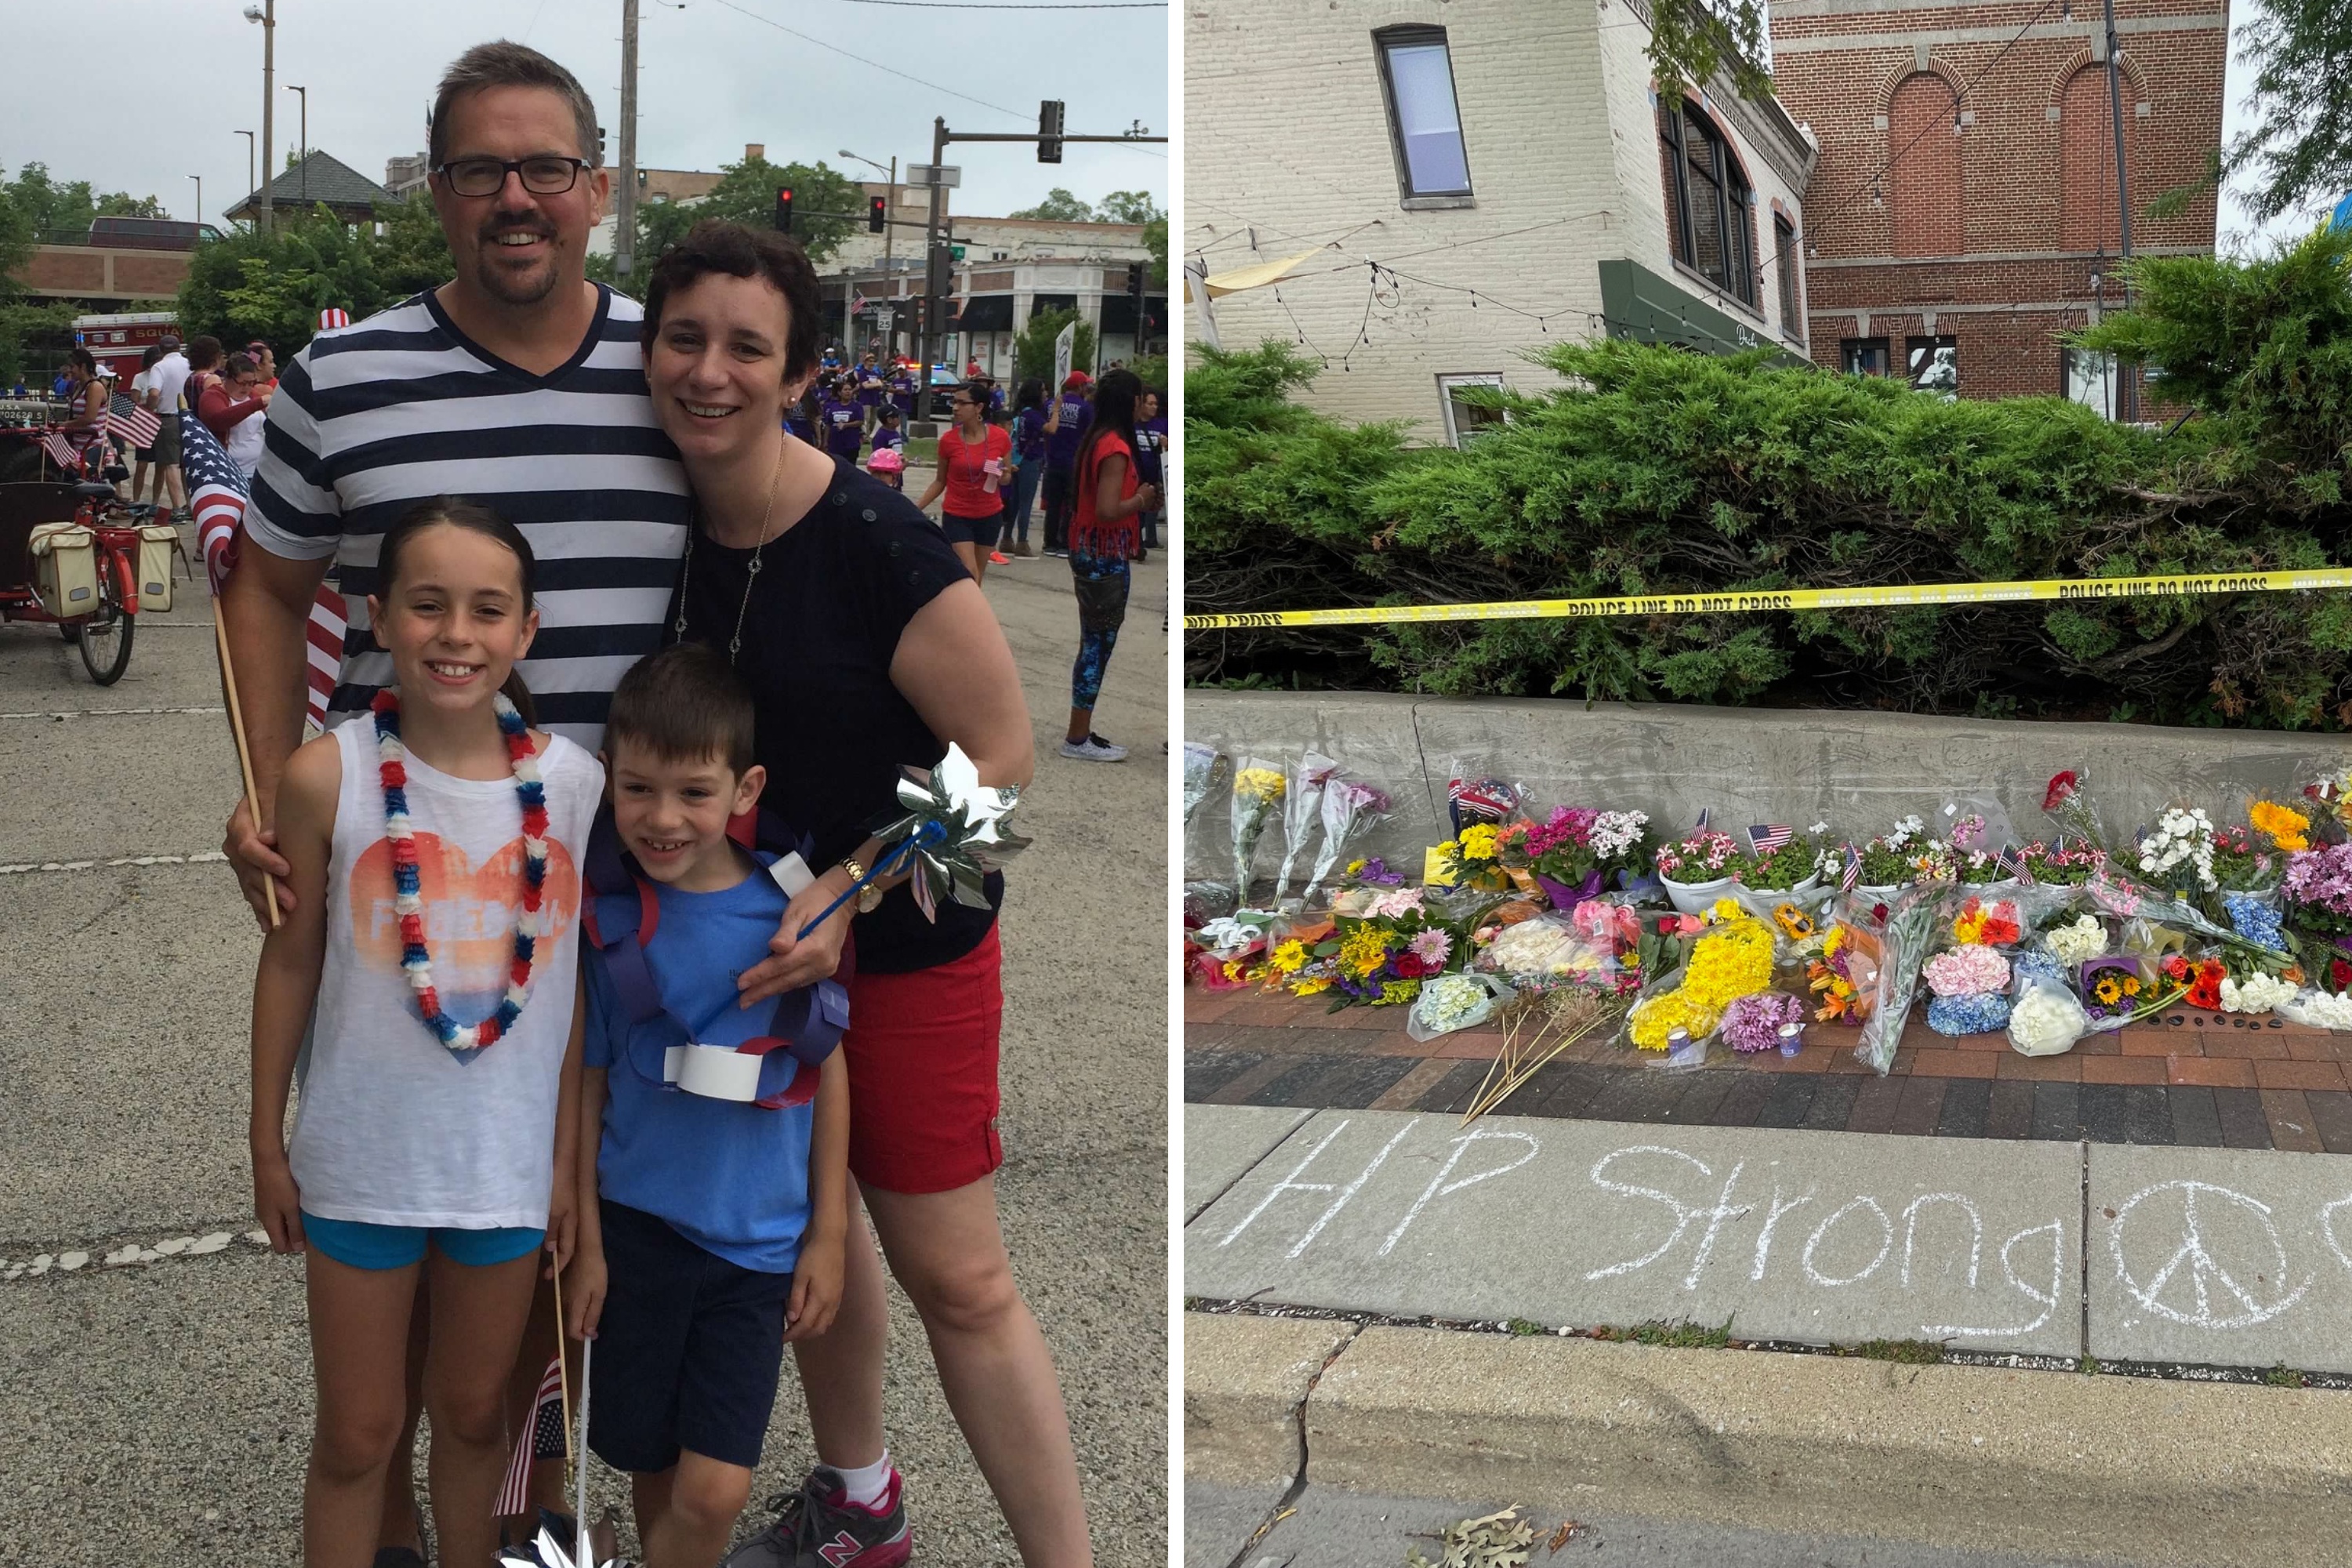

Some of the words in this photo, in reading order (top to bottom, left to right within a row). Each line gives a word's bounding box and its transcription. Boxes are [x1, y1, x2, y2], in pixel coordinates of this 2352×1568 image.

[2059, 584, 2114, 598] POLICE
[2158, 580, 2178, 595] DO
[2183, 579, 2213, 593] NOT
[2217, 576, 2268, 592] CROSS
[1568, 601, 1627, 615] POLICE
[1674, 598, 1697, 612] DO
[1701, 597, 1733, 612] NOT
[1738, 594, 1793, 609] CROSS
[1218, 1116, 1543, 1259] HP
[1584, 1144, 2064, 1338] Strong
